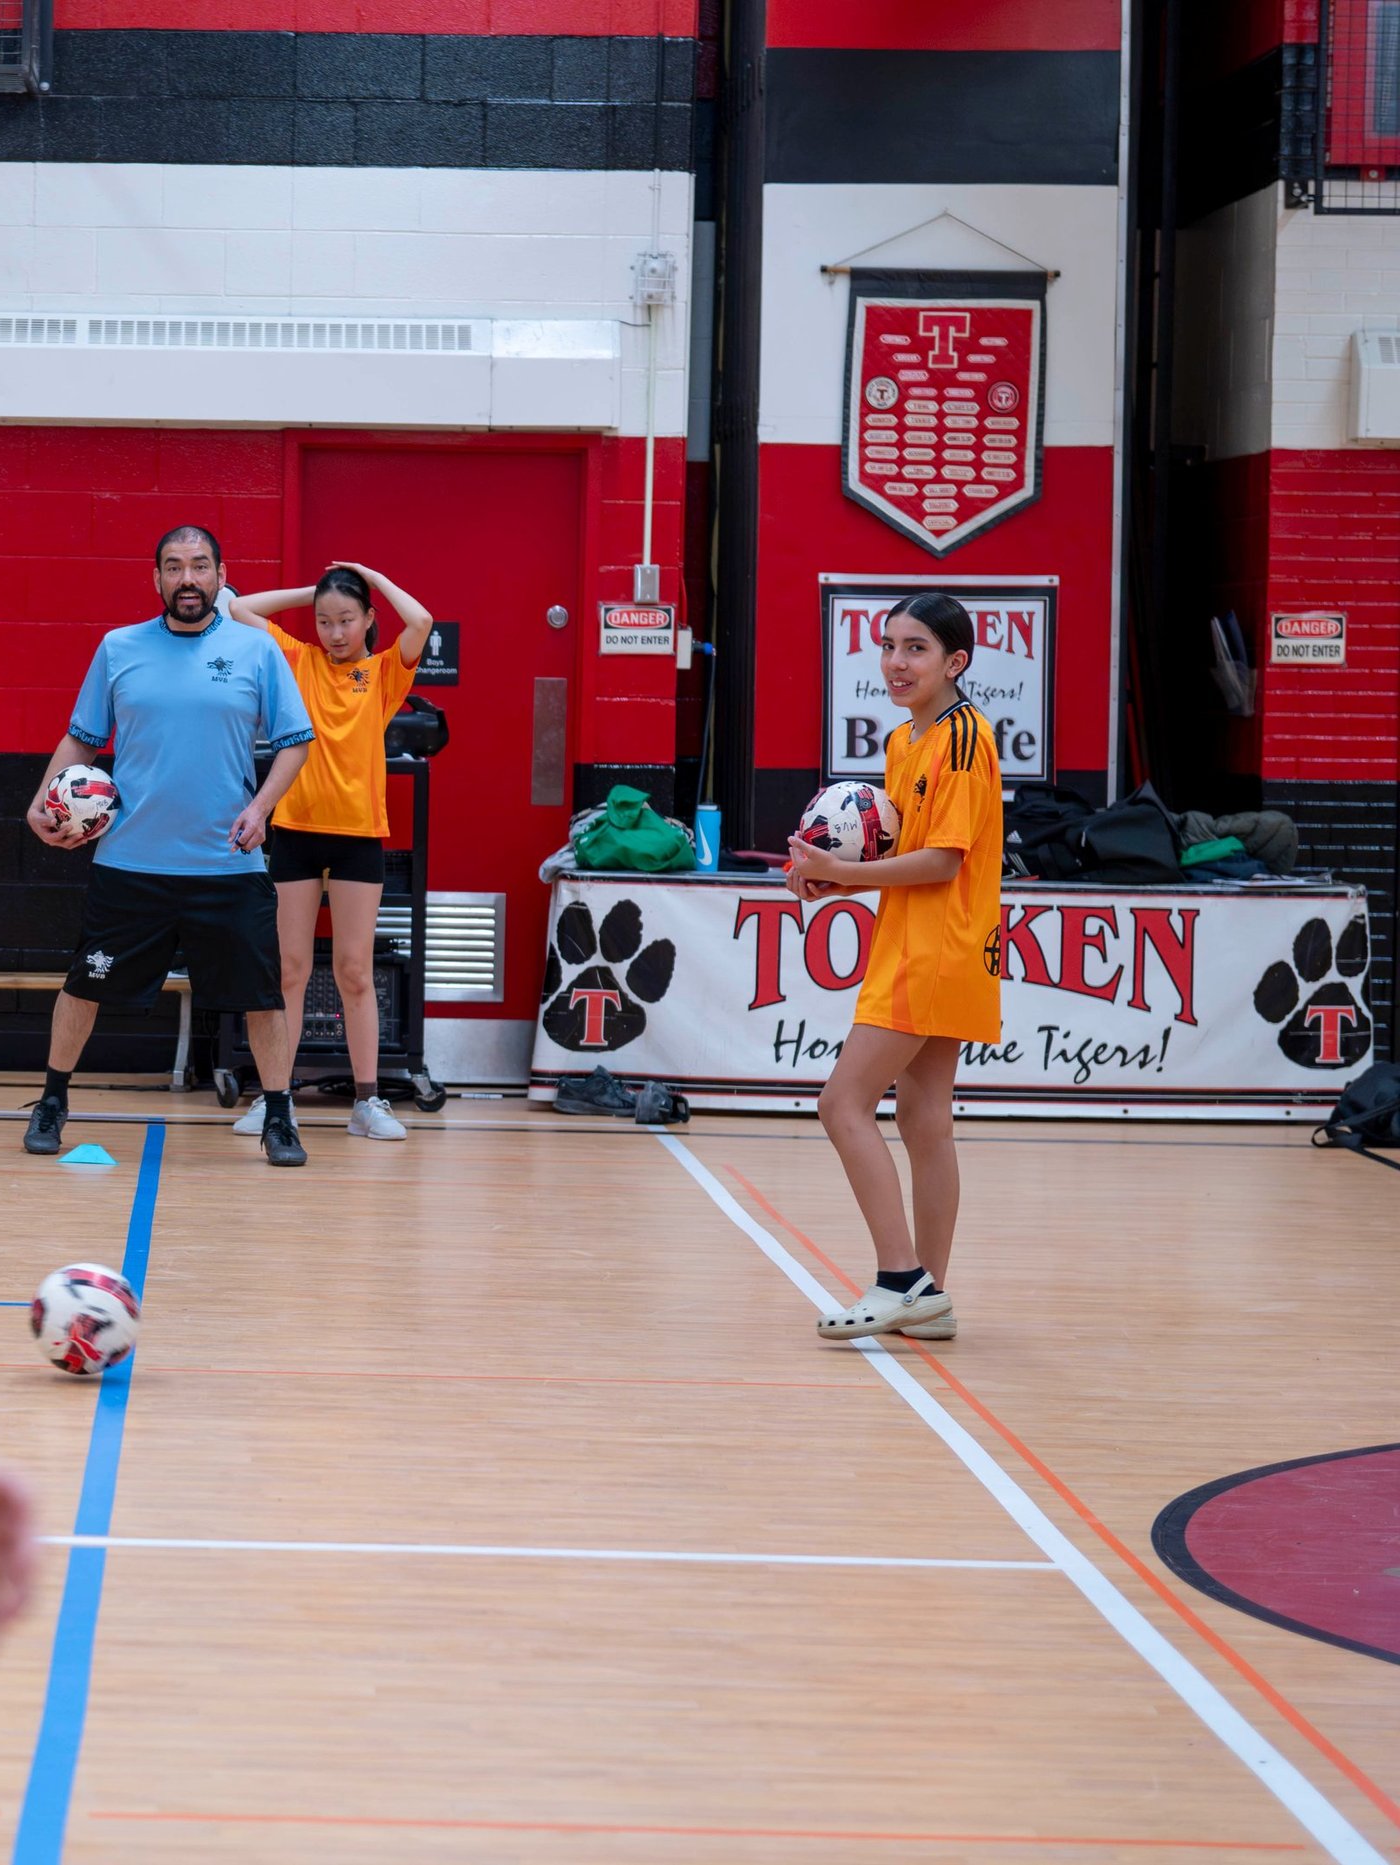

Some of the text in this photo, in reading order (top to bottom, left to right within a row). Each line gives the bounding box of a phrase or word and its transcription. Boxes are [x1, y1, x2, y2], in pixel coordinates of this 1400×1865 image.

[919, 311, 970, 368] T
[610, 611, 665, 625] DANGER
[840, 608, 1035, 660] TOEN
[1281, 621, 1337, 635] DANGER
[605, 635, 670, 645] DO NOT ENTER
[1276, 644, 1340, 657] DO NOT ENTER
[426, 658, 444, 667] Boys
[968, 681, 1024, 705] Tigers!
[733, 896, 1200, 1027] TOKEN
[569, 987, 623, 1046] T
[1303, 1004, 1358, 1064] T
[1037, 1024, 1172, 1084] Tigers!
